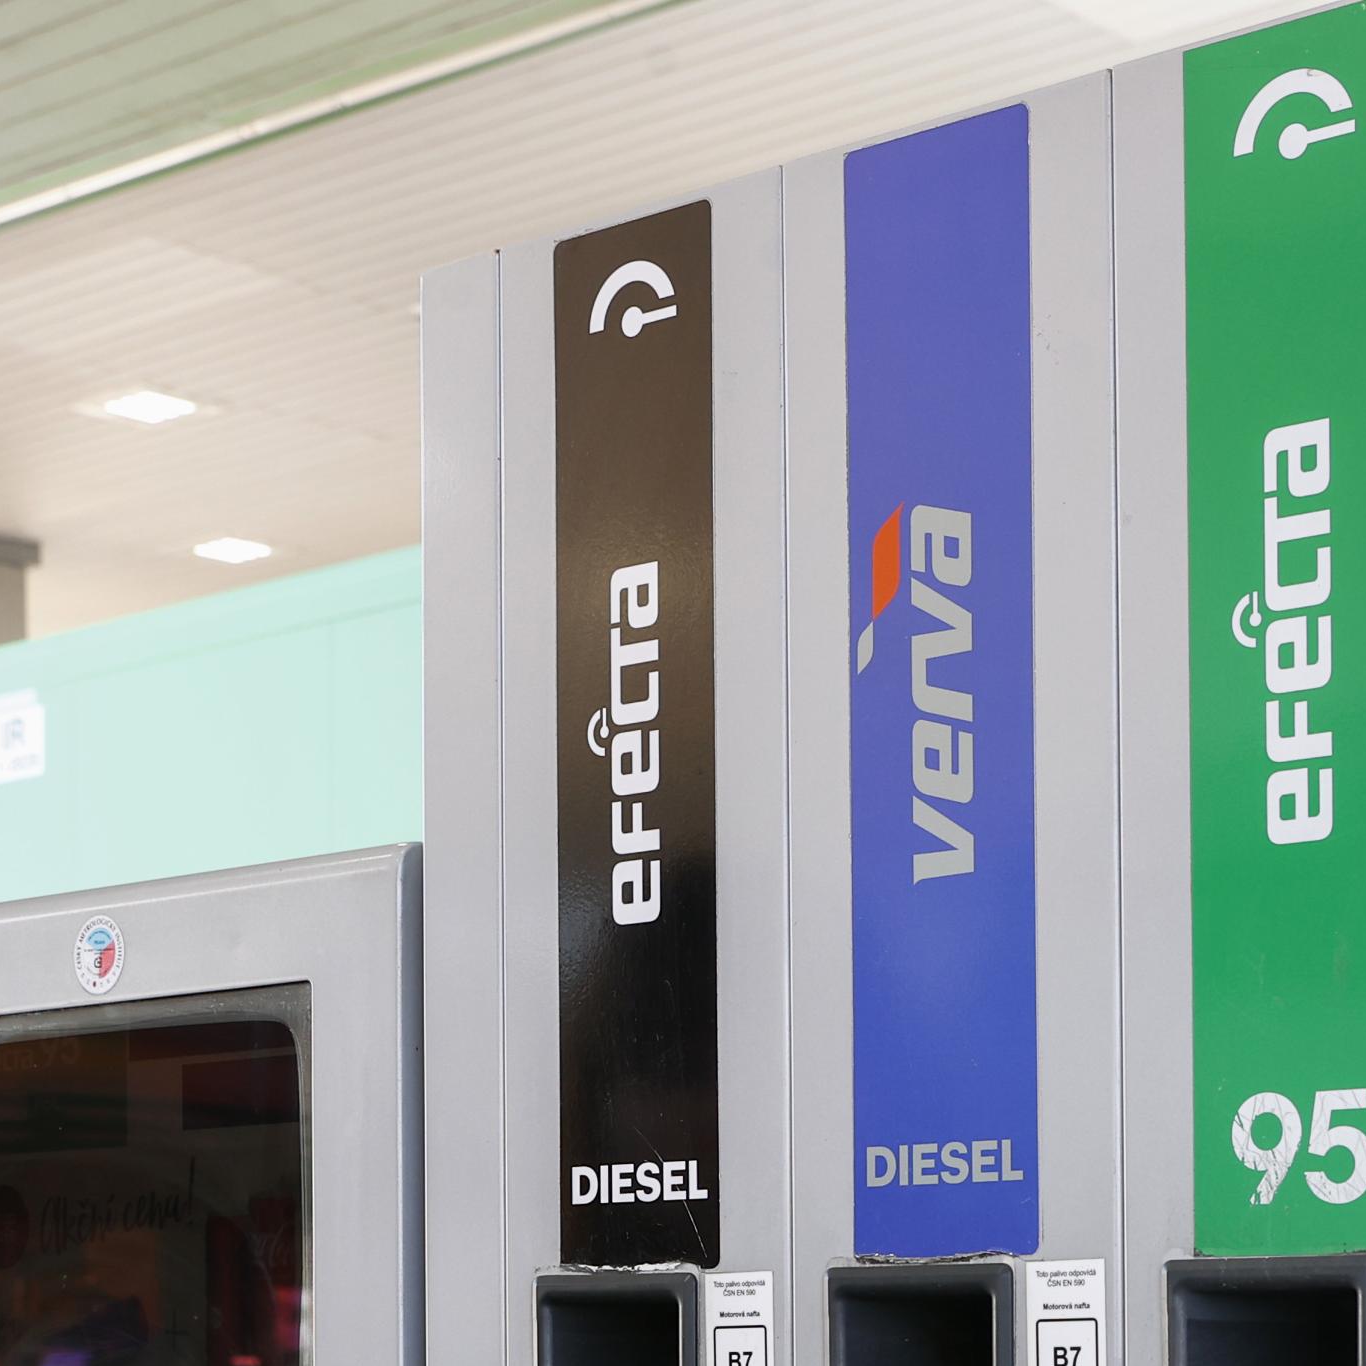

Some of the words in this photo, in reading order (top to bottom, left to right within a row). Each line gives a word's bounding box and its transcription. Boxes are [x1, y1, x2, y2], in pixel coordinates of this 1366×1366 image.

[1232, 417, 1333, 845] efecta
[910, 503, 975, 885] verva
[587, 561, 661, 926] efecta
[571, 1159, 709, 1206] DIESEL
[866, 1138, 1024, 1189] DIESEL
[726, 1280, 741, 1288] palivo
[1047, 1278, 1061, 1287] ČSN
[1050, 1270, 1067, 1279] palivo
[1043, 1302, 1073, 1310] Motorová
